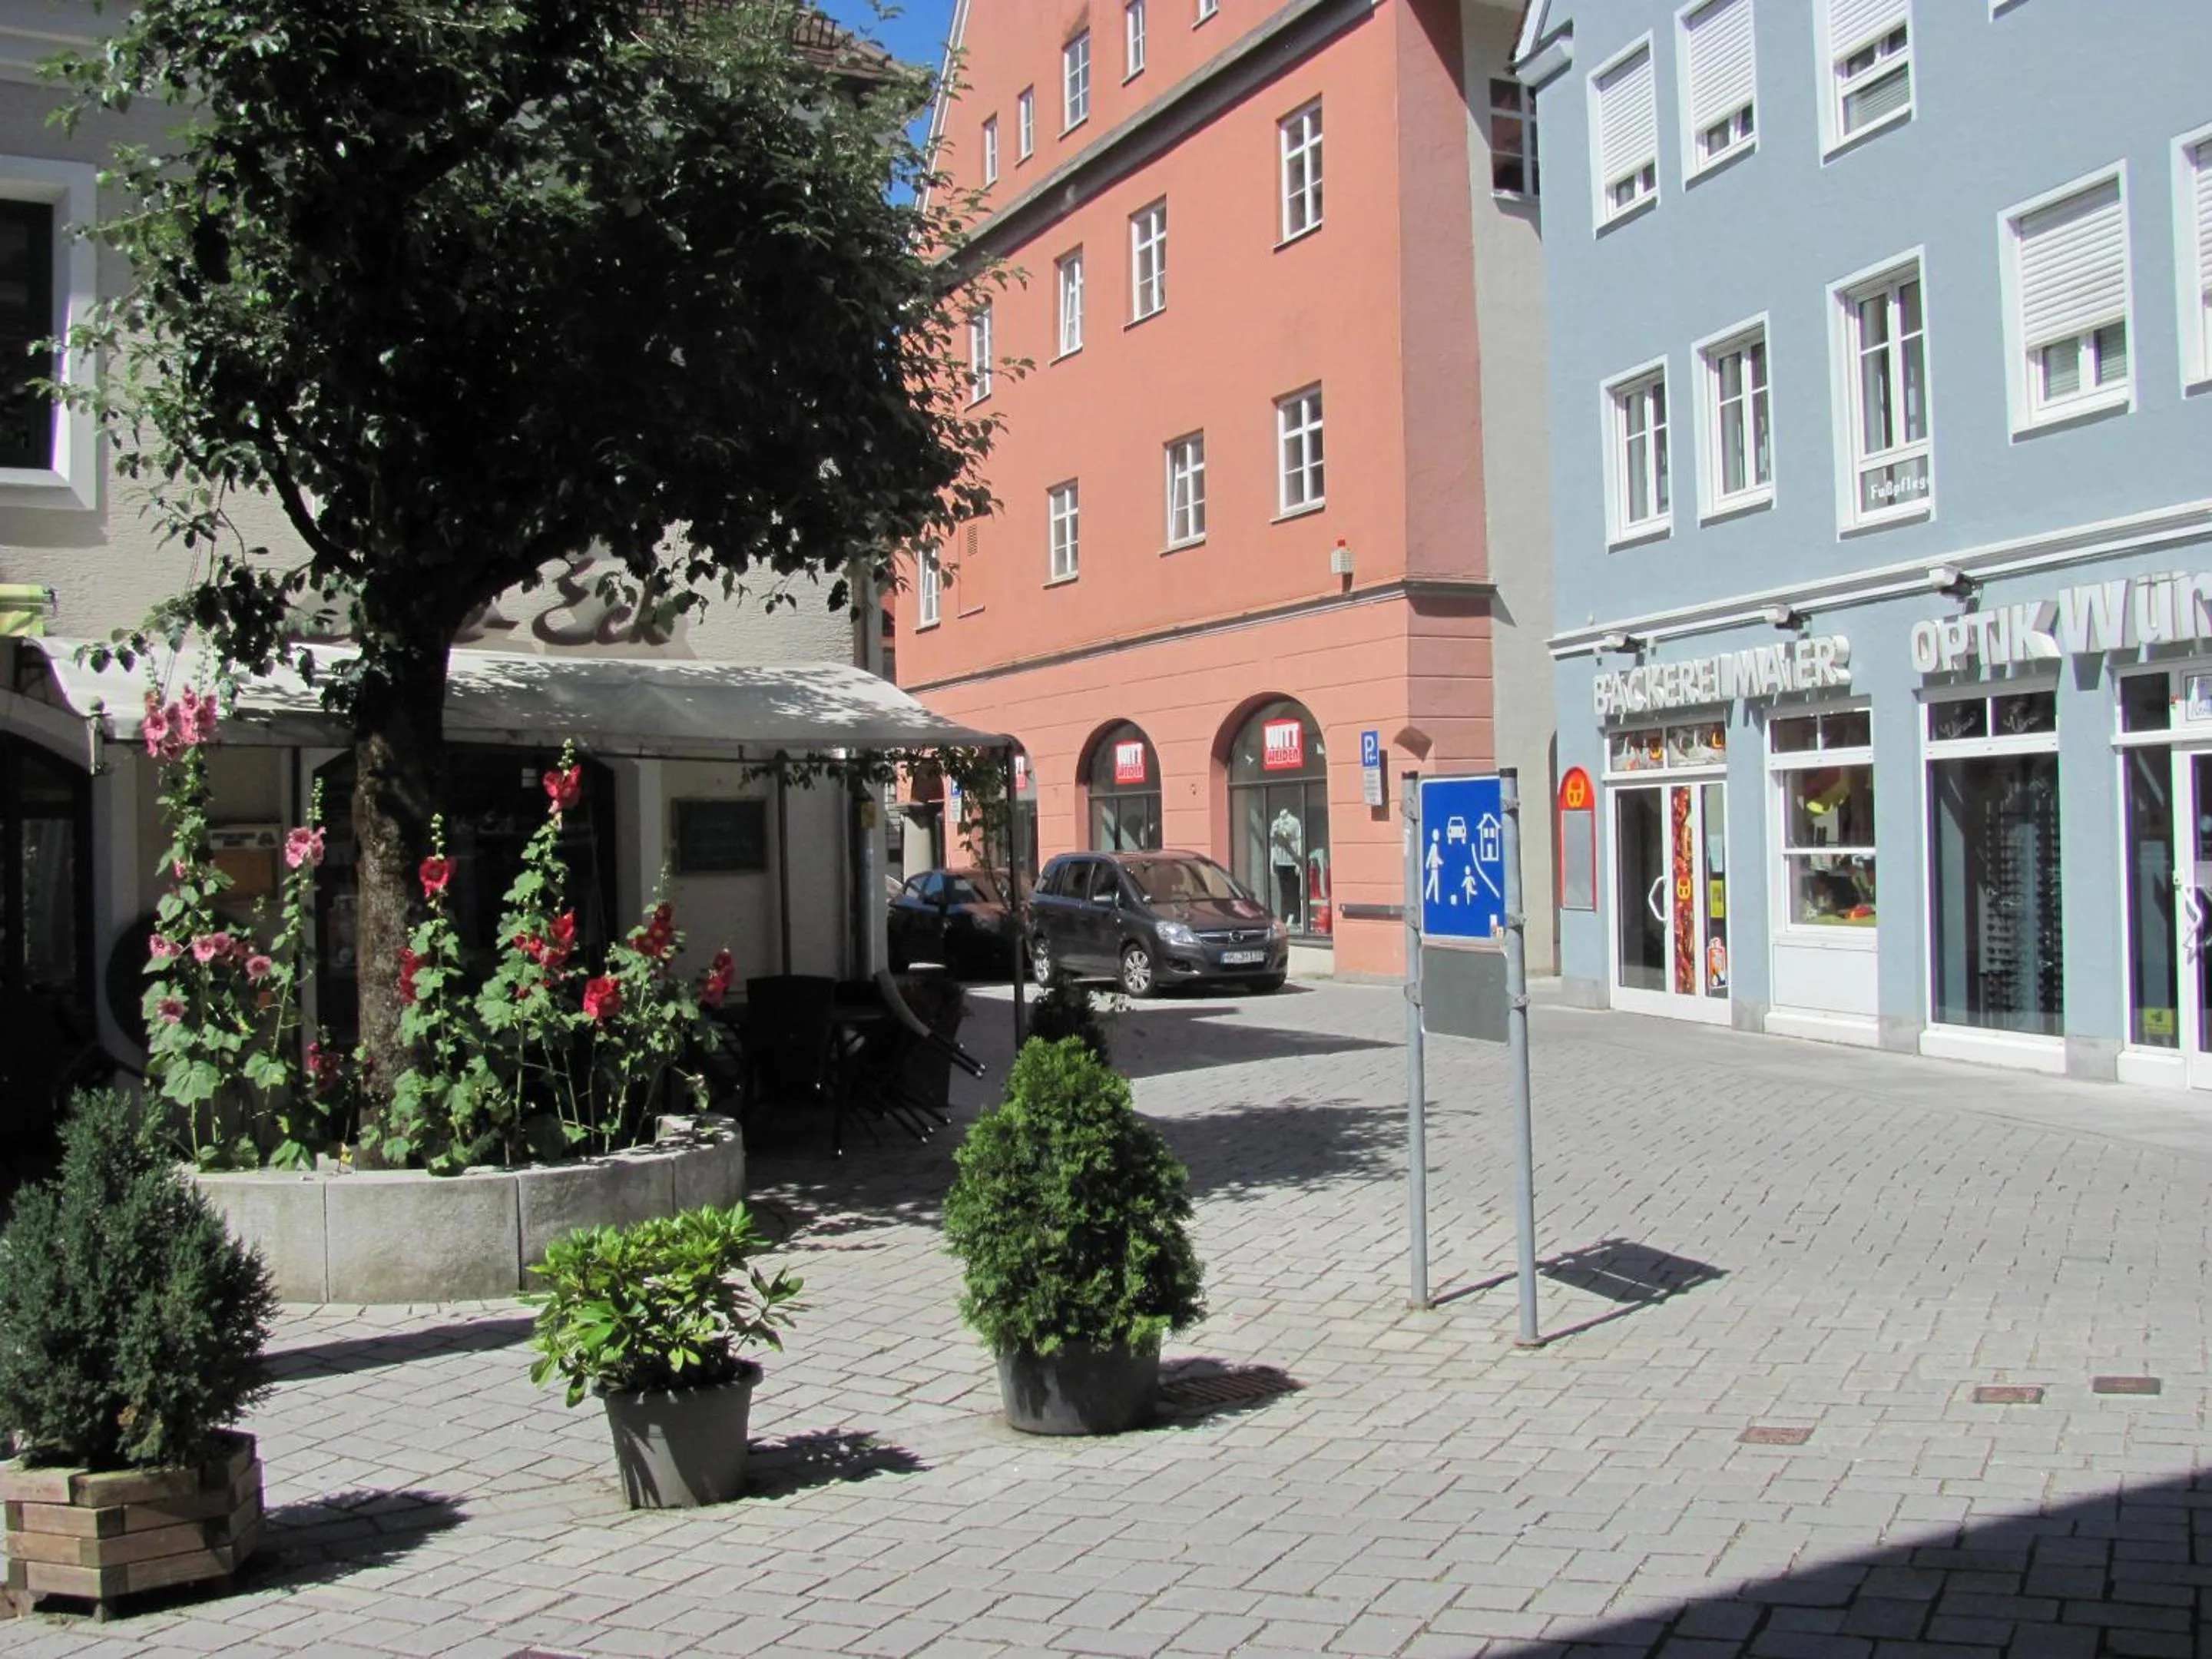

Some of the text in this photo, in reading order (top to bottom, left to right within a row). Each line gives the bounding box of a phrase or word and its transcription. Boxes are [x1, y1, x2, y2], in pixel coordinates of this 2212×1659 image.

[1870, 475, 1929, 501] Fußpfleg
[1911, 601, 2061, 674] OPTIK
[1732, 635, 1852, 698] MAIER
[1265, 722, 1299, 750] WITT
[1364, 735, 1374, 763] P
